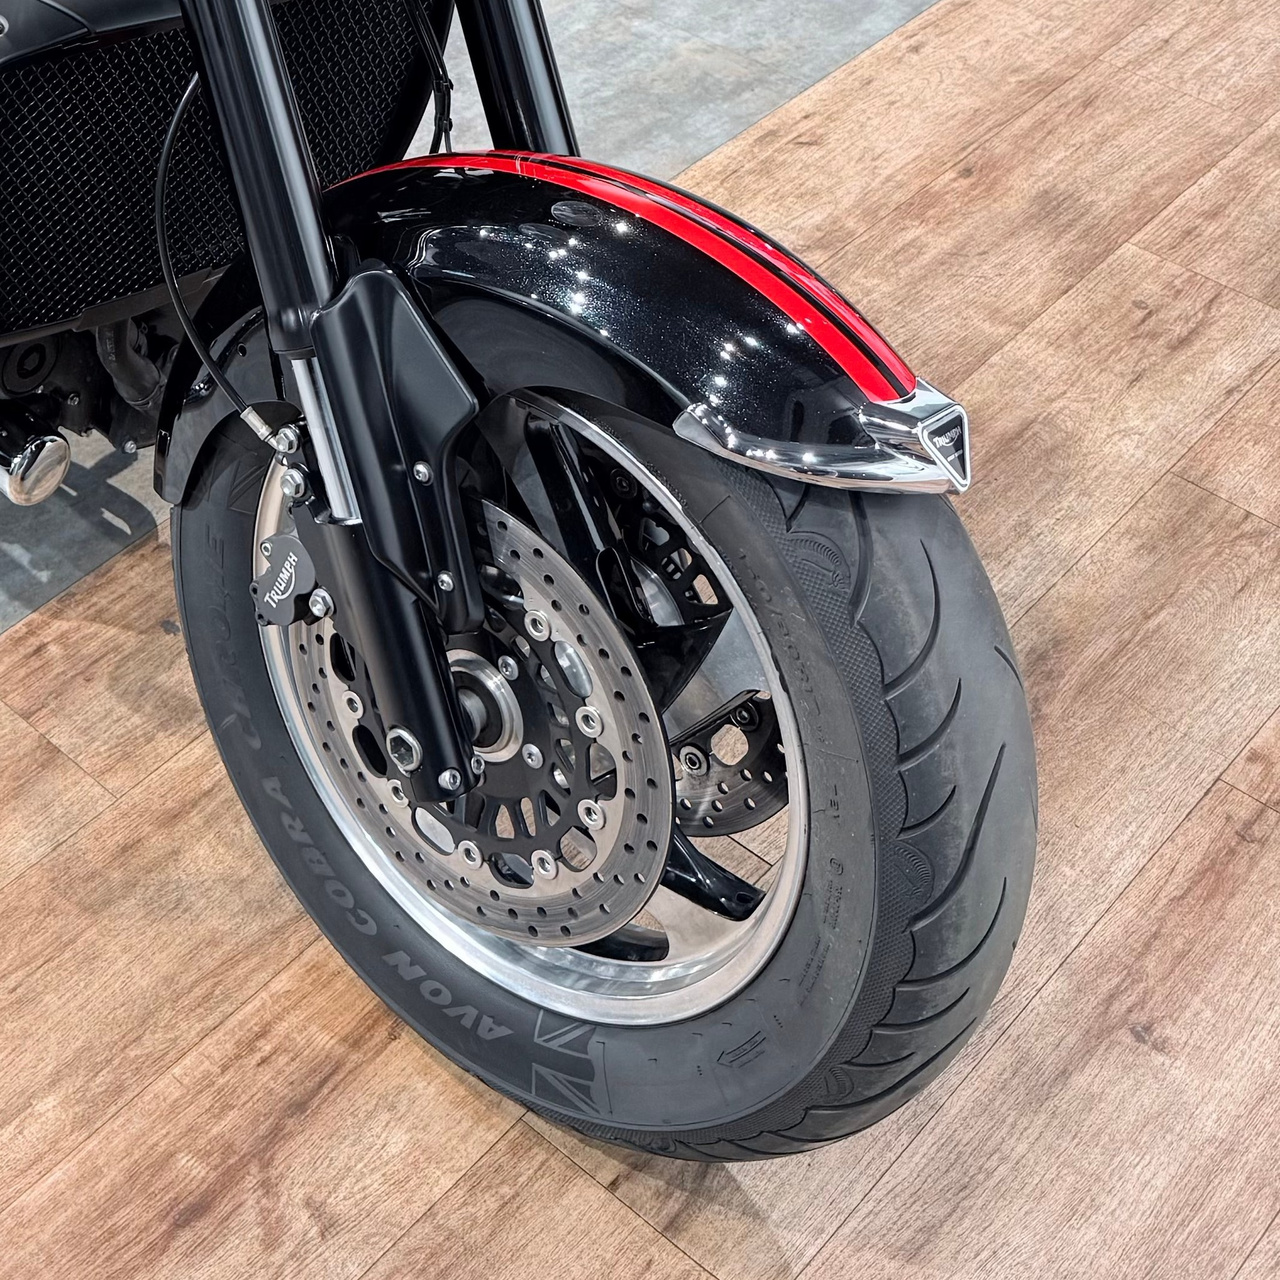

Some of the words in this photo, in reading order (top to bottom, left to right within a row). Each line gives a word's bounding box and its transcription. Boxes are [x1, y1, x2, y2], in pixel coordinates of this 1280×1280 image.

[933, 425, 962, 449] TRIUMPH
[264, 551, 298, 608] TRIUMPH
[261, 776, 378, 936] COBRA
[381, 950, 515, 1041] AVON
